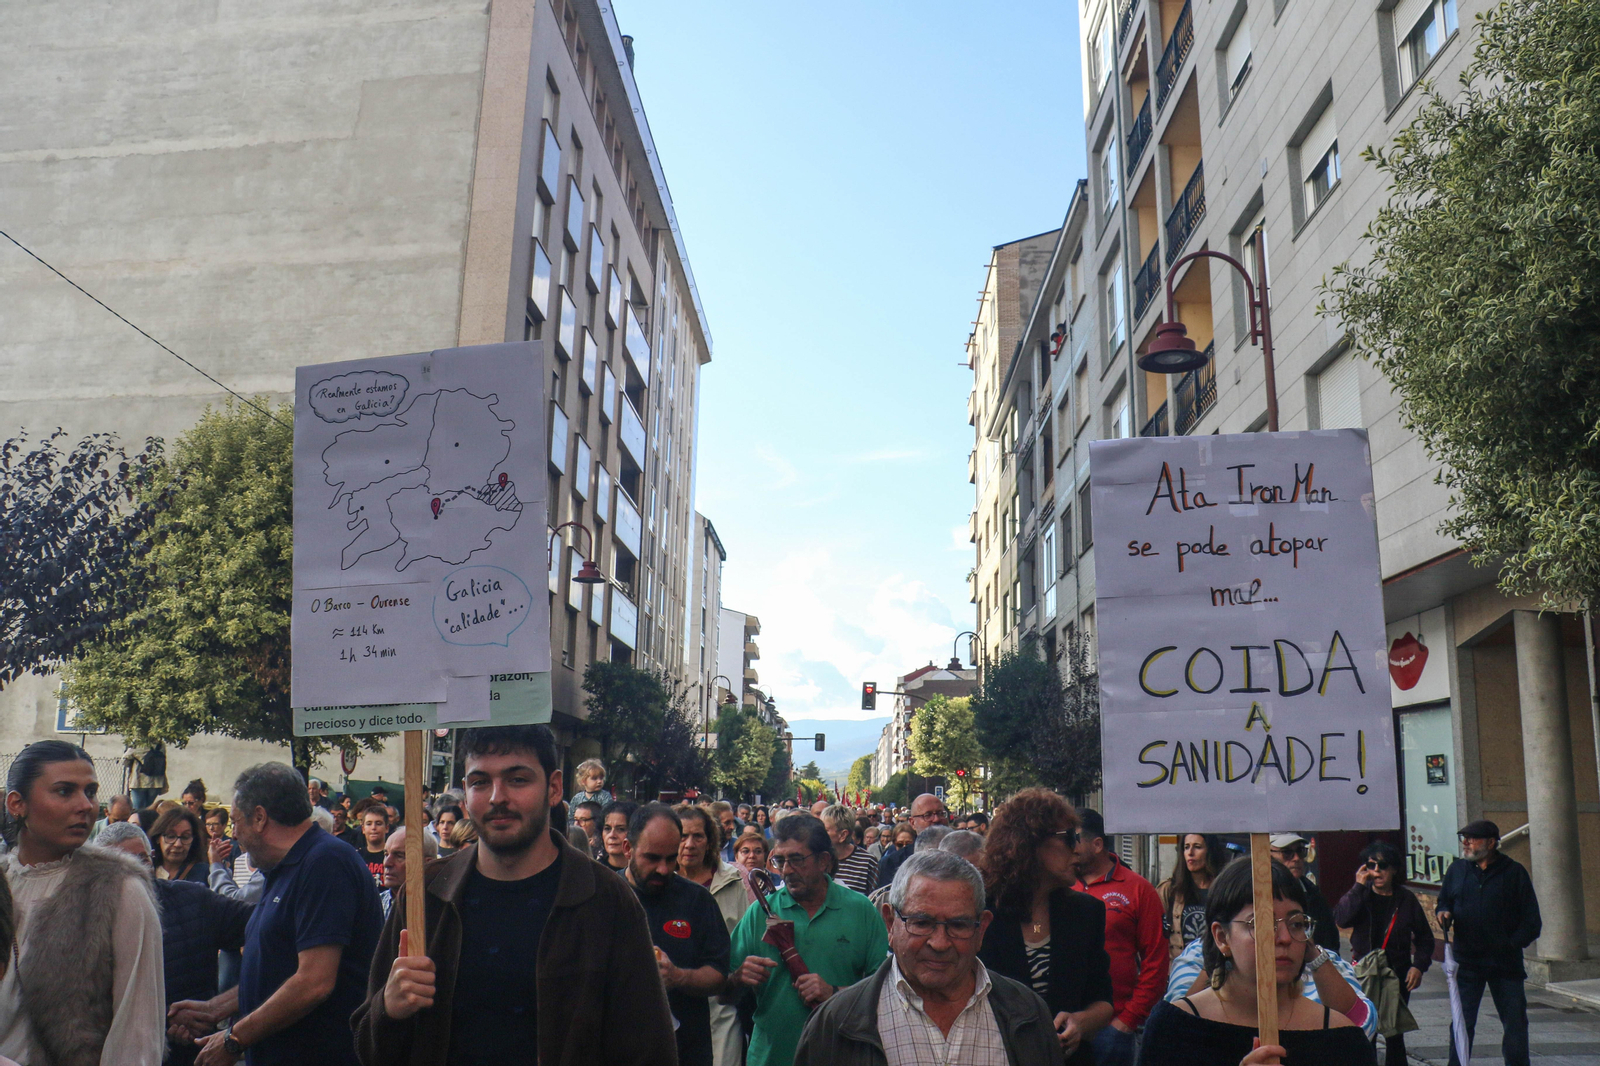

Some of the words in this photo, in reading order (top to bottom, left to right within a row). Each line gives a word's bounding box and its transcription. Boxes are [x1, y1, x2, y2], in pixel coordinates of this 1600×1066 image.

[366, 379, 397, 394] estamos
[355, 395, 395, 411] Galicia?
[1146, 461, 1218, 515] Ata
[1127, 540, 1159, 557] se
[1177, 525, 1230, 573] pode
[1250, 522, 1328, 569] atopar
[446, 578, 503, 602] Galicia
[324, 597, 351, 613] Barco
[371, 595, 411, 609] Ourense
[350, 624, 368, 637] 114
[363, 644, 378, 658] 34
[380, 646, 397, 658] min
[1138, 630, 1366, 697] COIDA
[304, 718, 356, 732] precioso
[359, 718, 367, 730] y
[369, 715, 394, 727] dice
[395, 713, 427, 725] todo.
[1244, 701, 1272, 733] A
[1137, 729, 1369, 795] SANIDADE!
